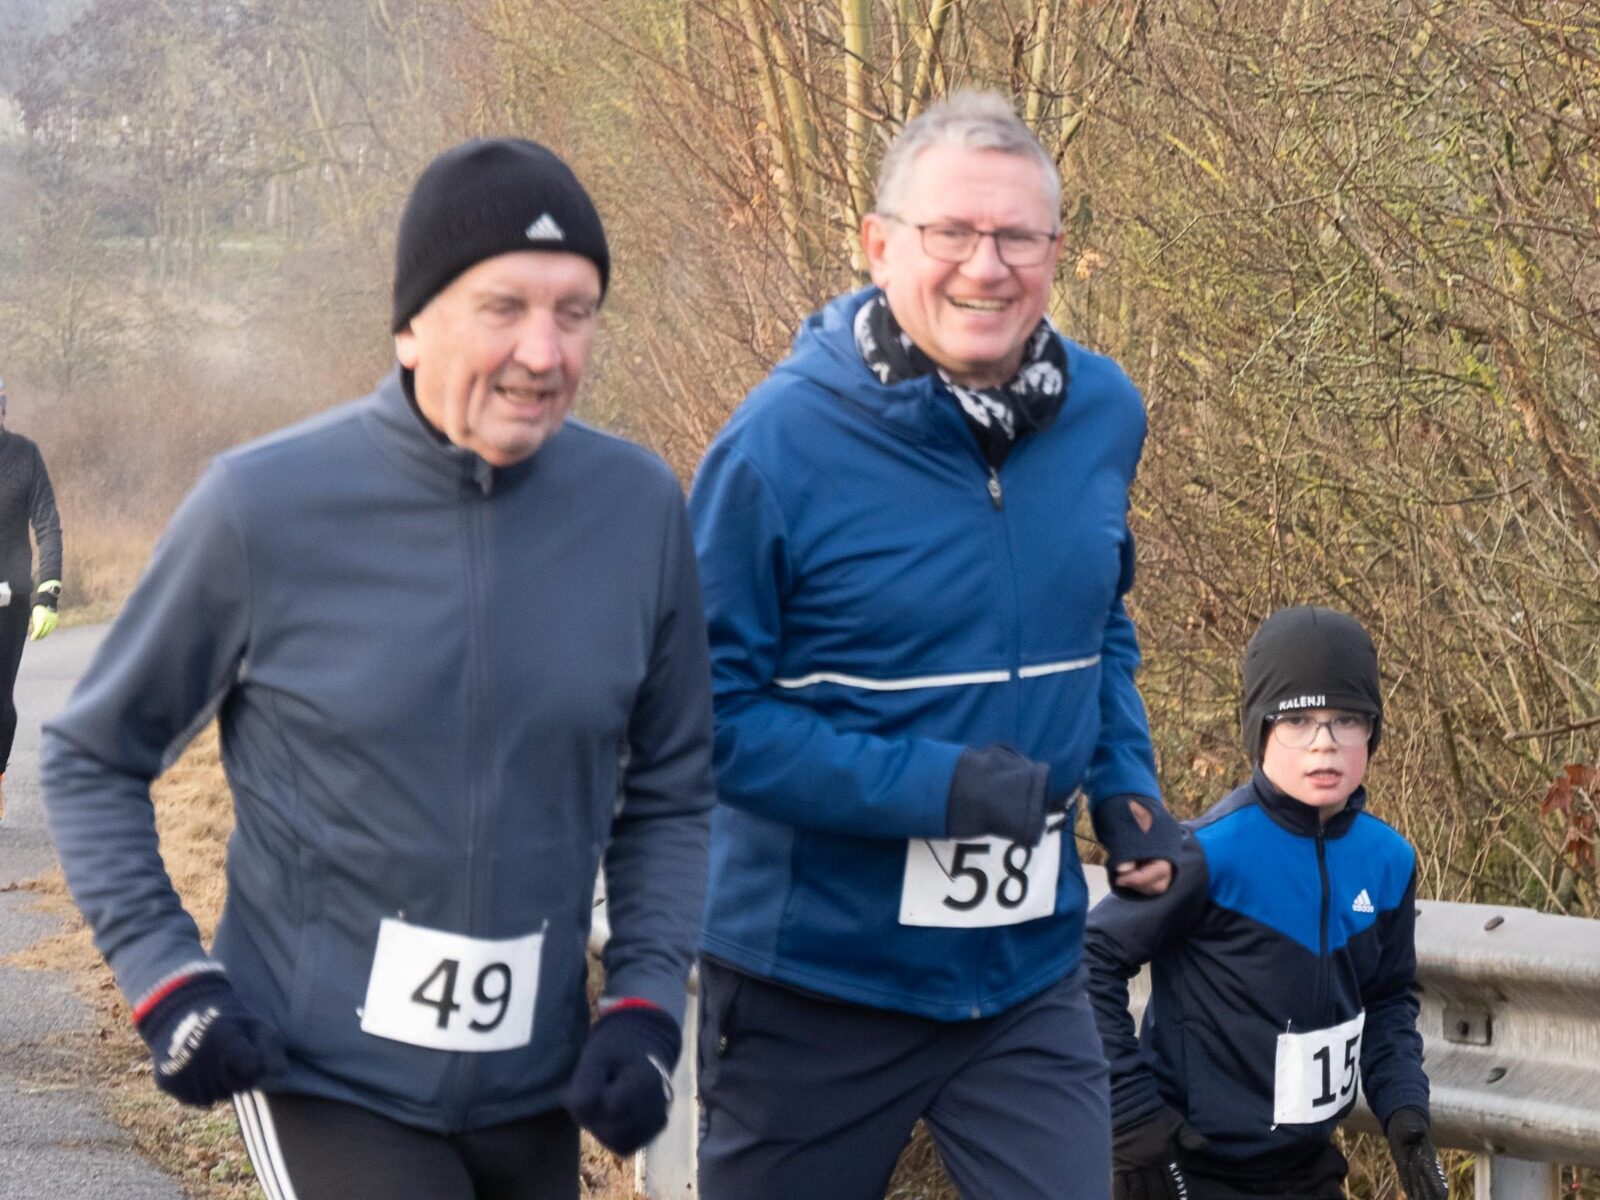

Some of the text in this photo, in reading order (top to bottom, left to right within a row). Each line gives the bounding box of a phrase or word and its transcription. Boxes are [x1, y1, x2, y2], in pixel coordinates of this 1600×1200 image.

[1279, 695, 1326, 710] KALENJI
[942, 841, 1032, 911] 58
[410, 958, 512, 1033] 49
[1312, 1034, 1360, 1108] 15
